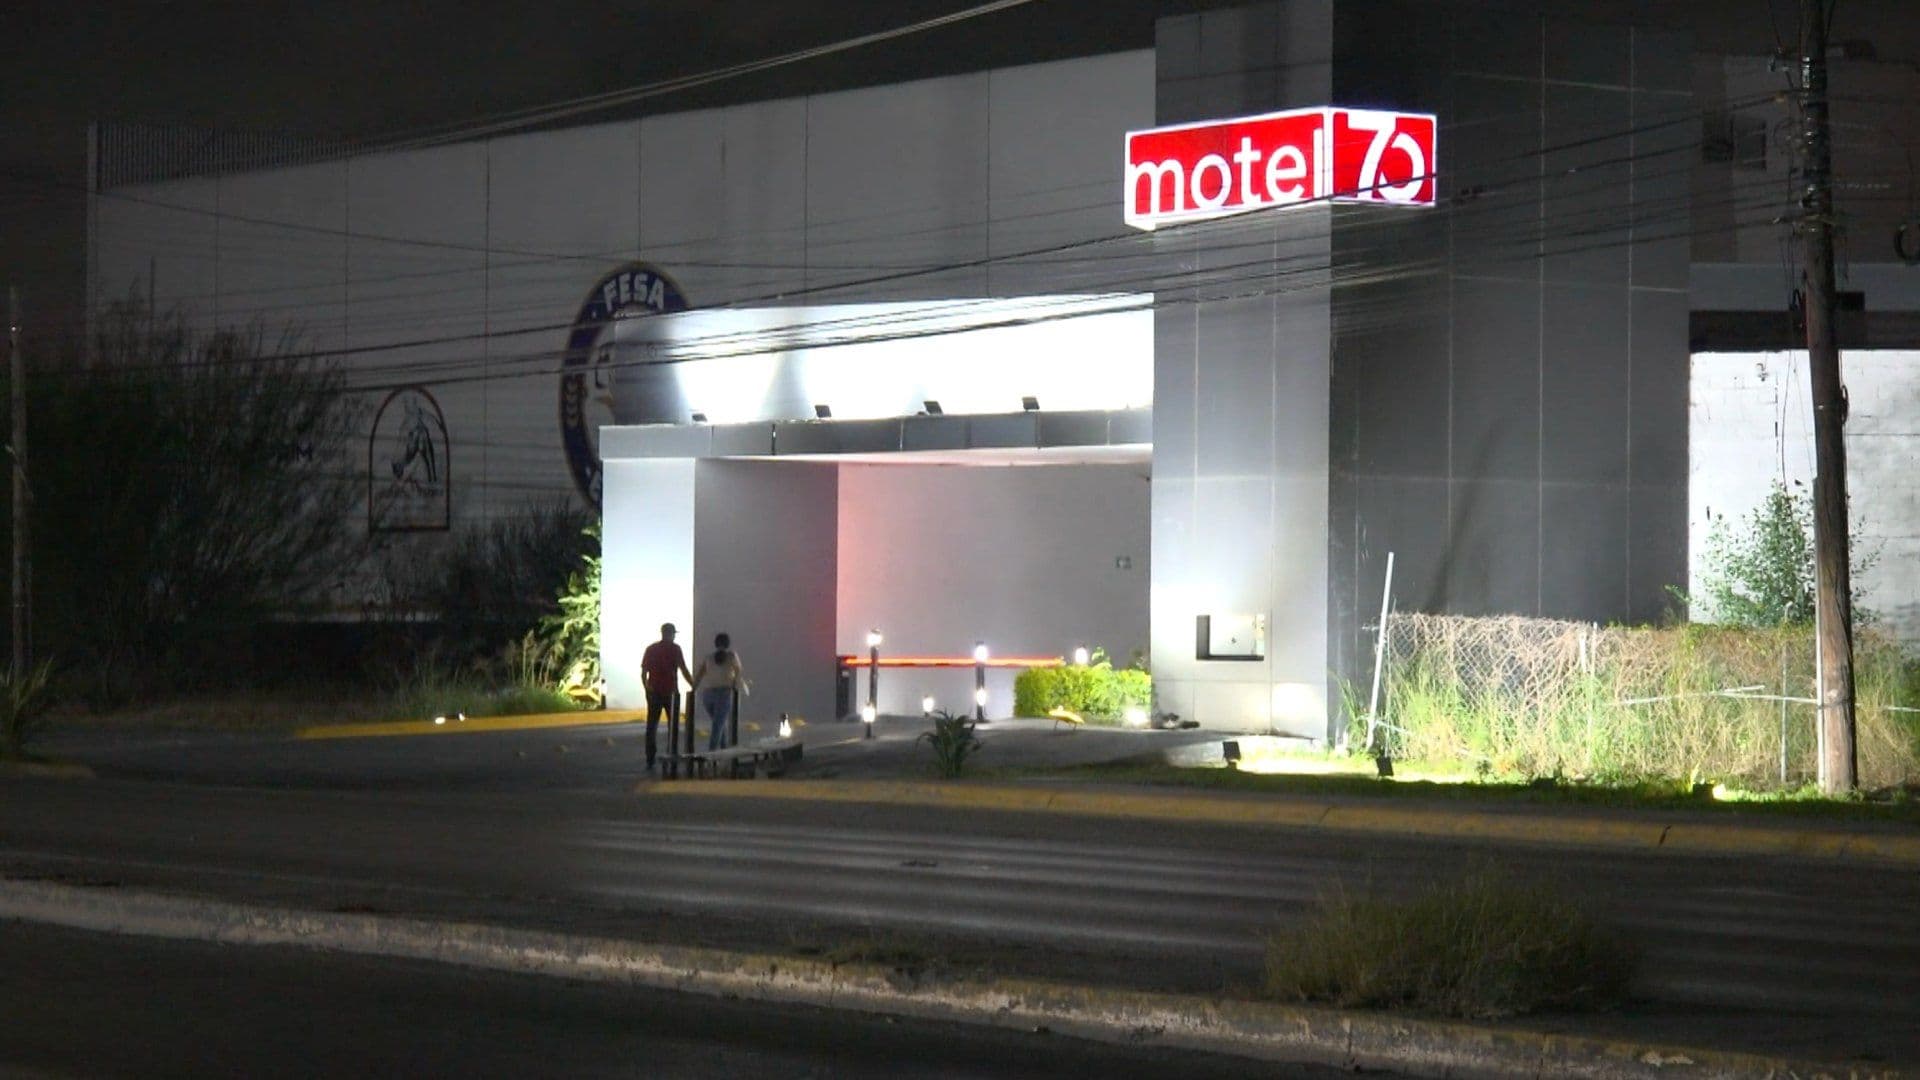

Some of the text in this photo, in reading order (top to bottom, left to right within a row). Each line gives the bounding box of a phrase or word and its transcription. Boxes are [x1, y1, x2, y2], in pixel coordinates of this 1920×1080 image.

[1127, 110, 1425, 214] motel 70
[604, 272, 664, 313] FESA
